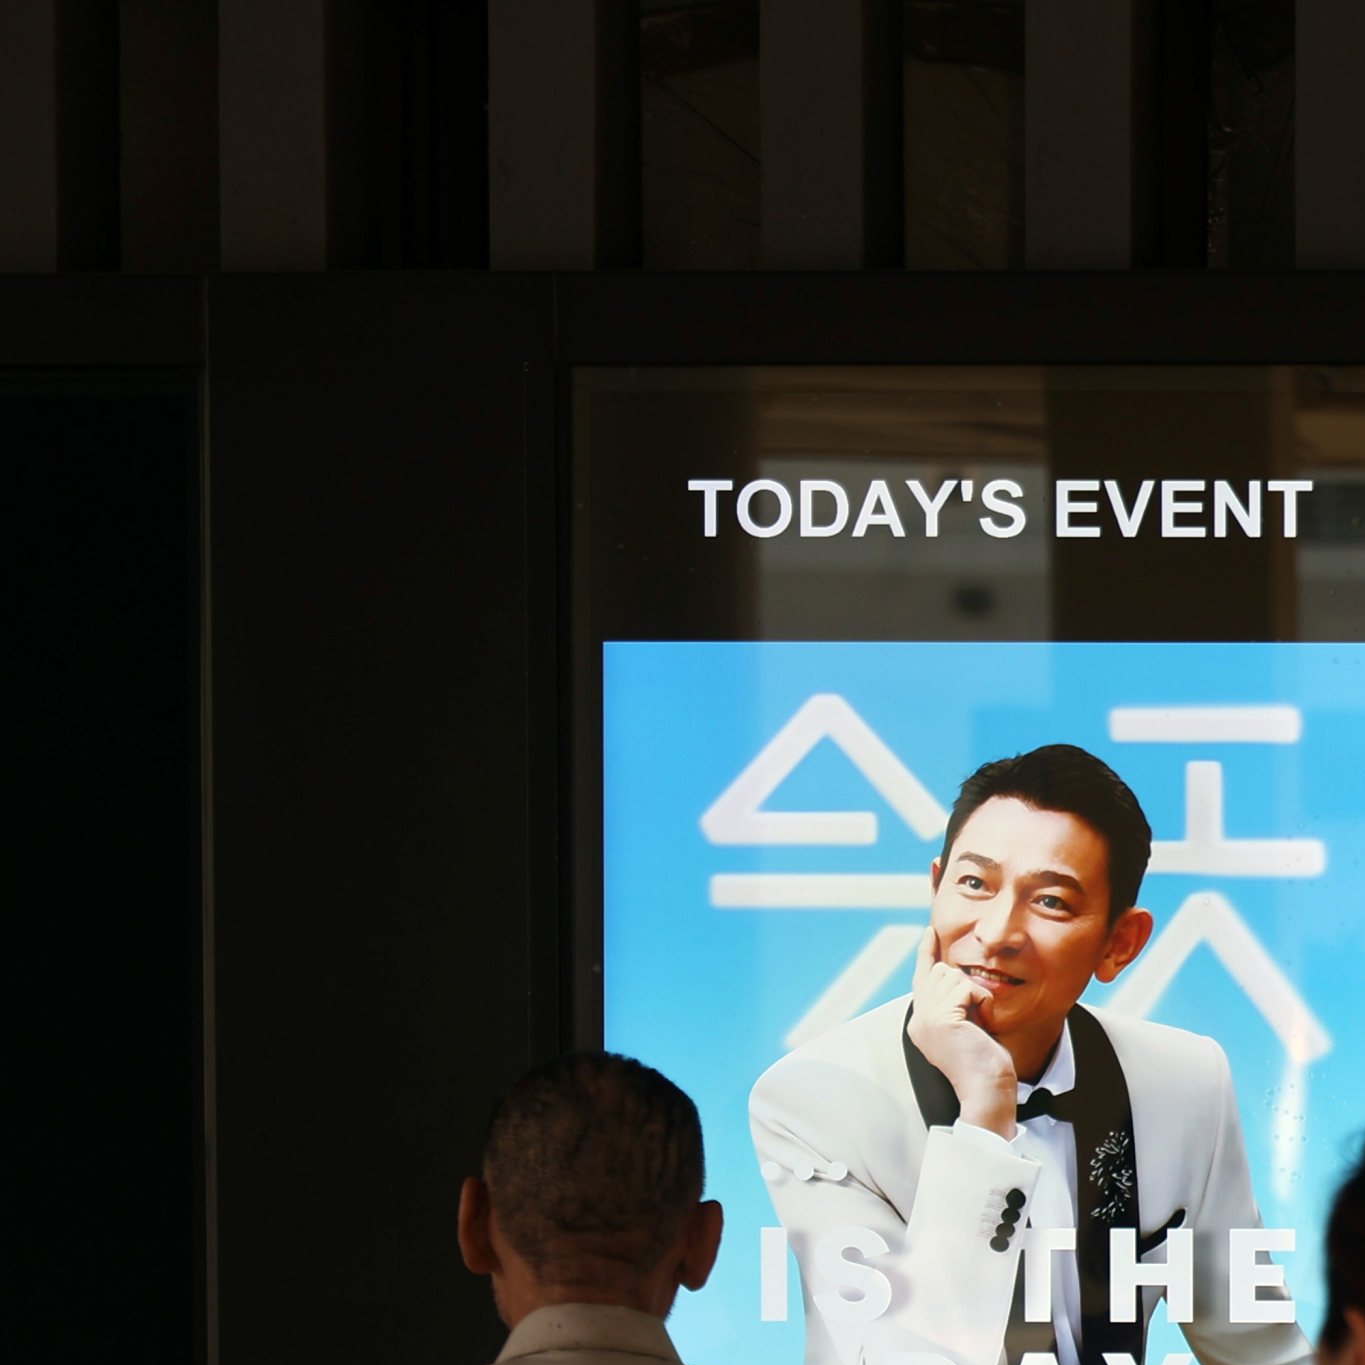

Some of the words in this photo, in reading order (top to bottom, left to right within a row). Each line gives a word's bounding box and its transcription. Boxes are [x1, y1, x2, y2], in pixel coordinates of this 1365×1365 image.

[688, 479, 1027, 539] TODAY'S
[1055, 479, 1313, 539] EVENT
[760, 1226, 893, 1323] IS
[1000, 1227, 1297, 1323] THE
